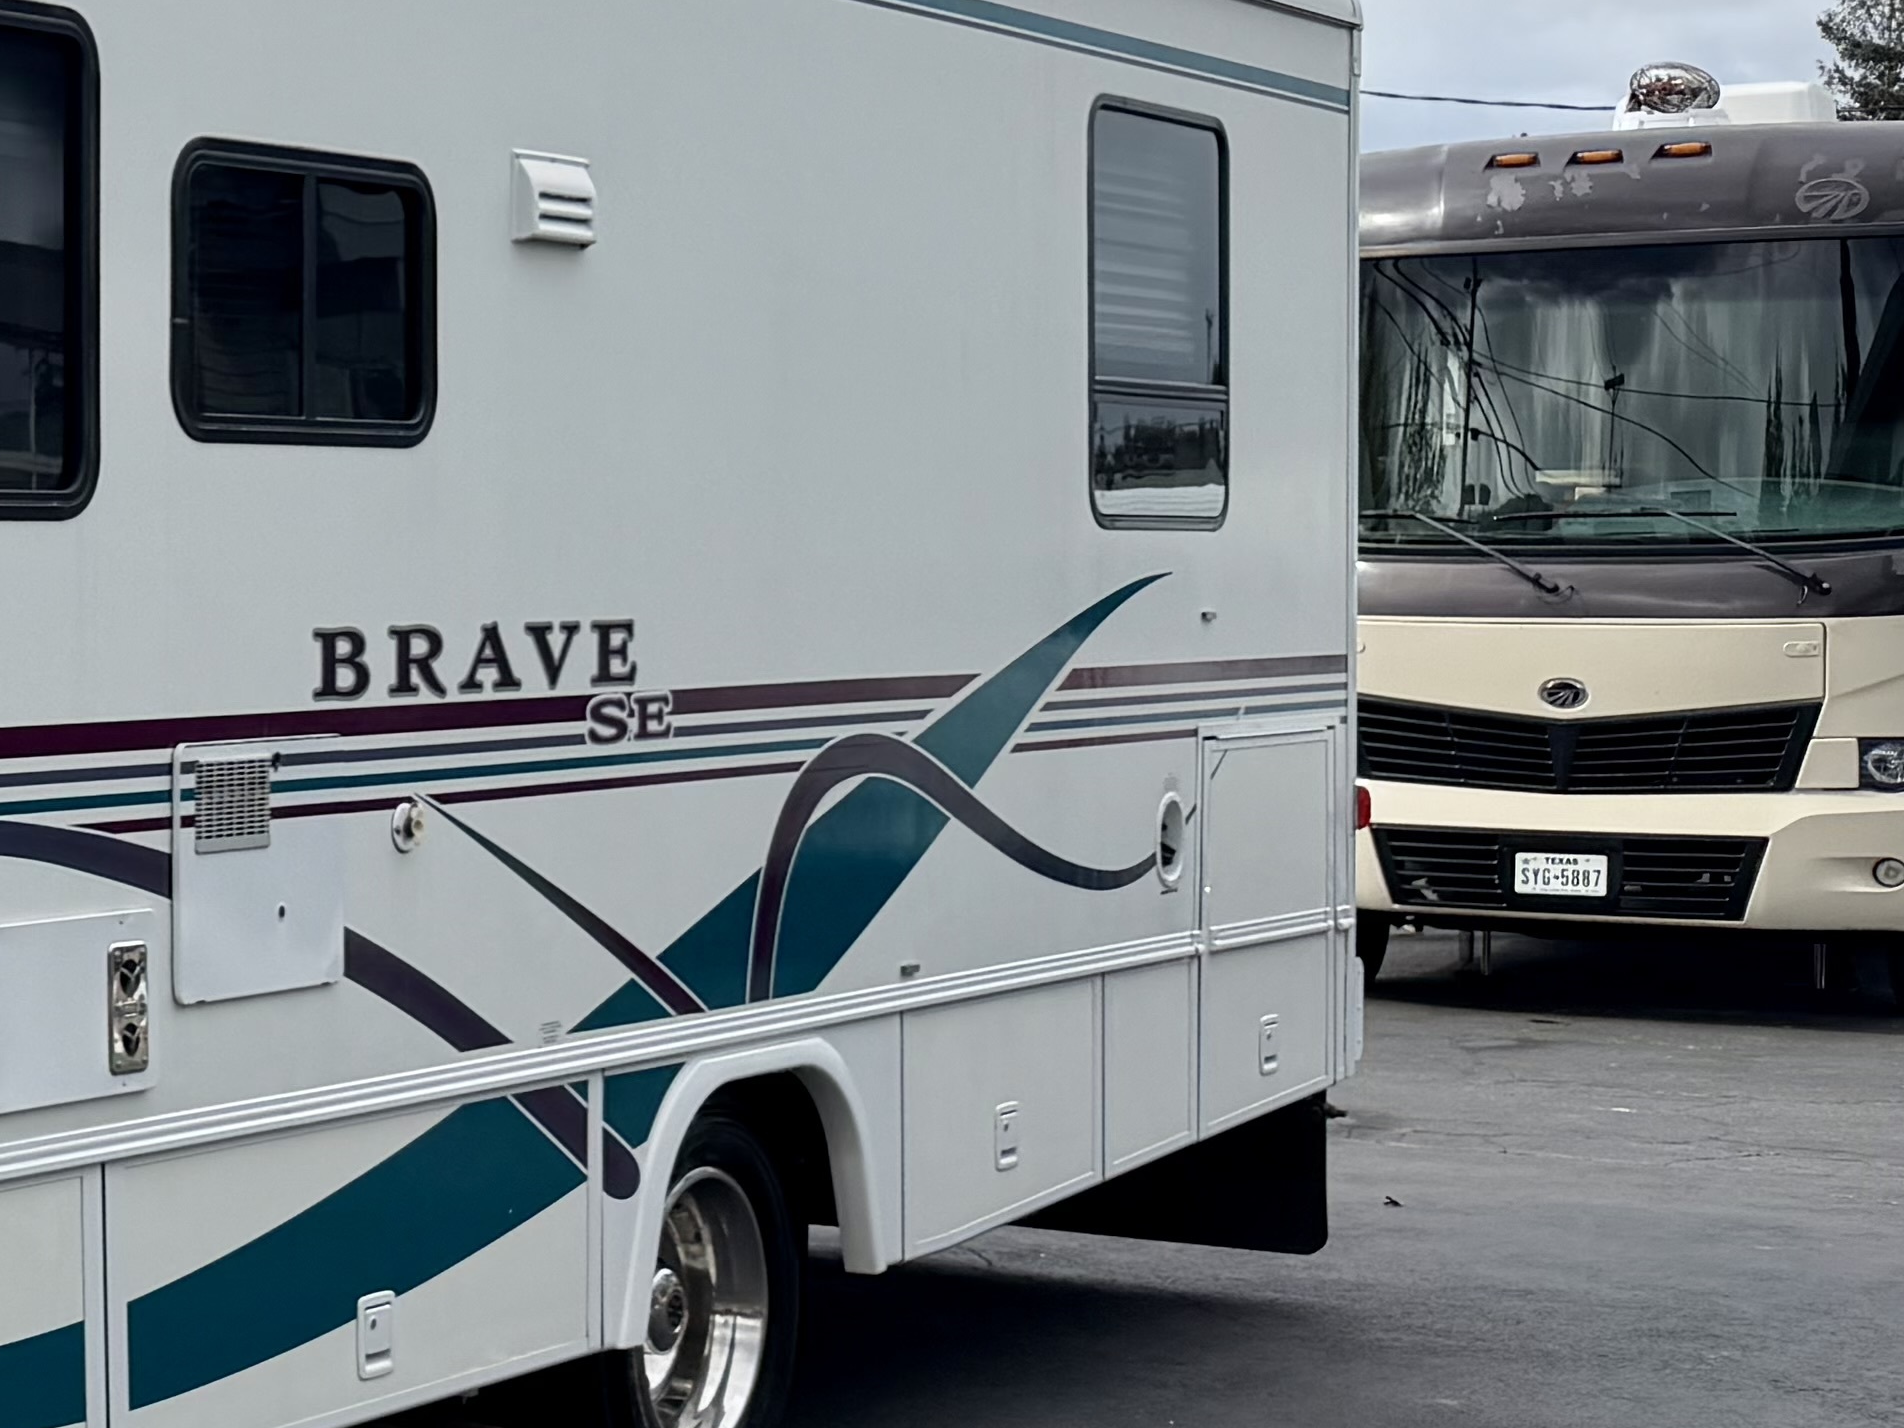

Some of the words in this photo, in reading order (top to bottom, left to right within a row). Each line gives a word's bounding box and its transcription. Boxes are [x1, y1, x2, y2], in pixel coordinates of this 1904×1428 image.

[312, 619, 638, 702] BRAVE
[587, 690, 674, 746] SE
[1544, 857, 1579, 865] TEXAS
